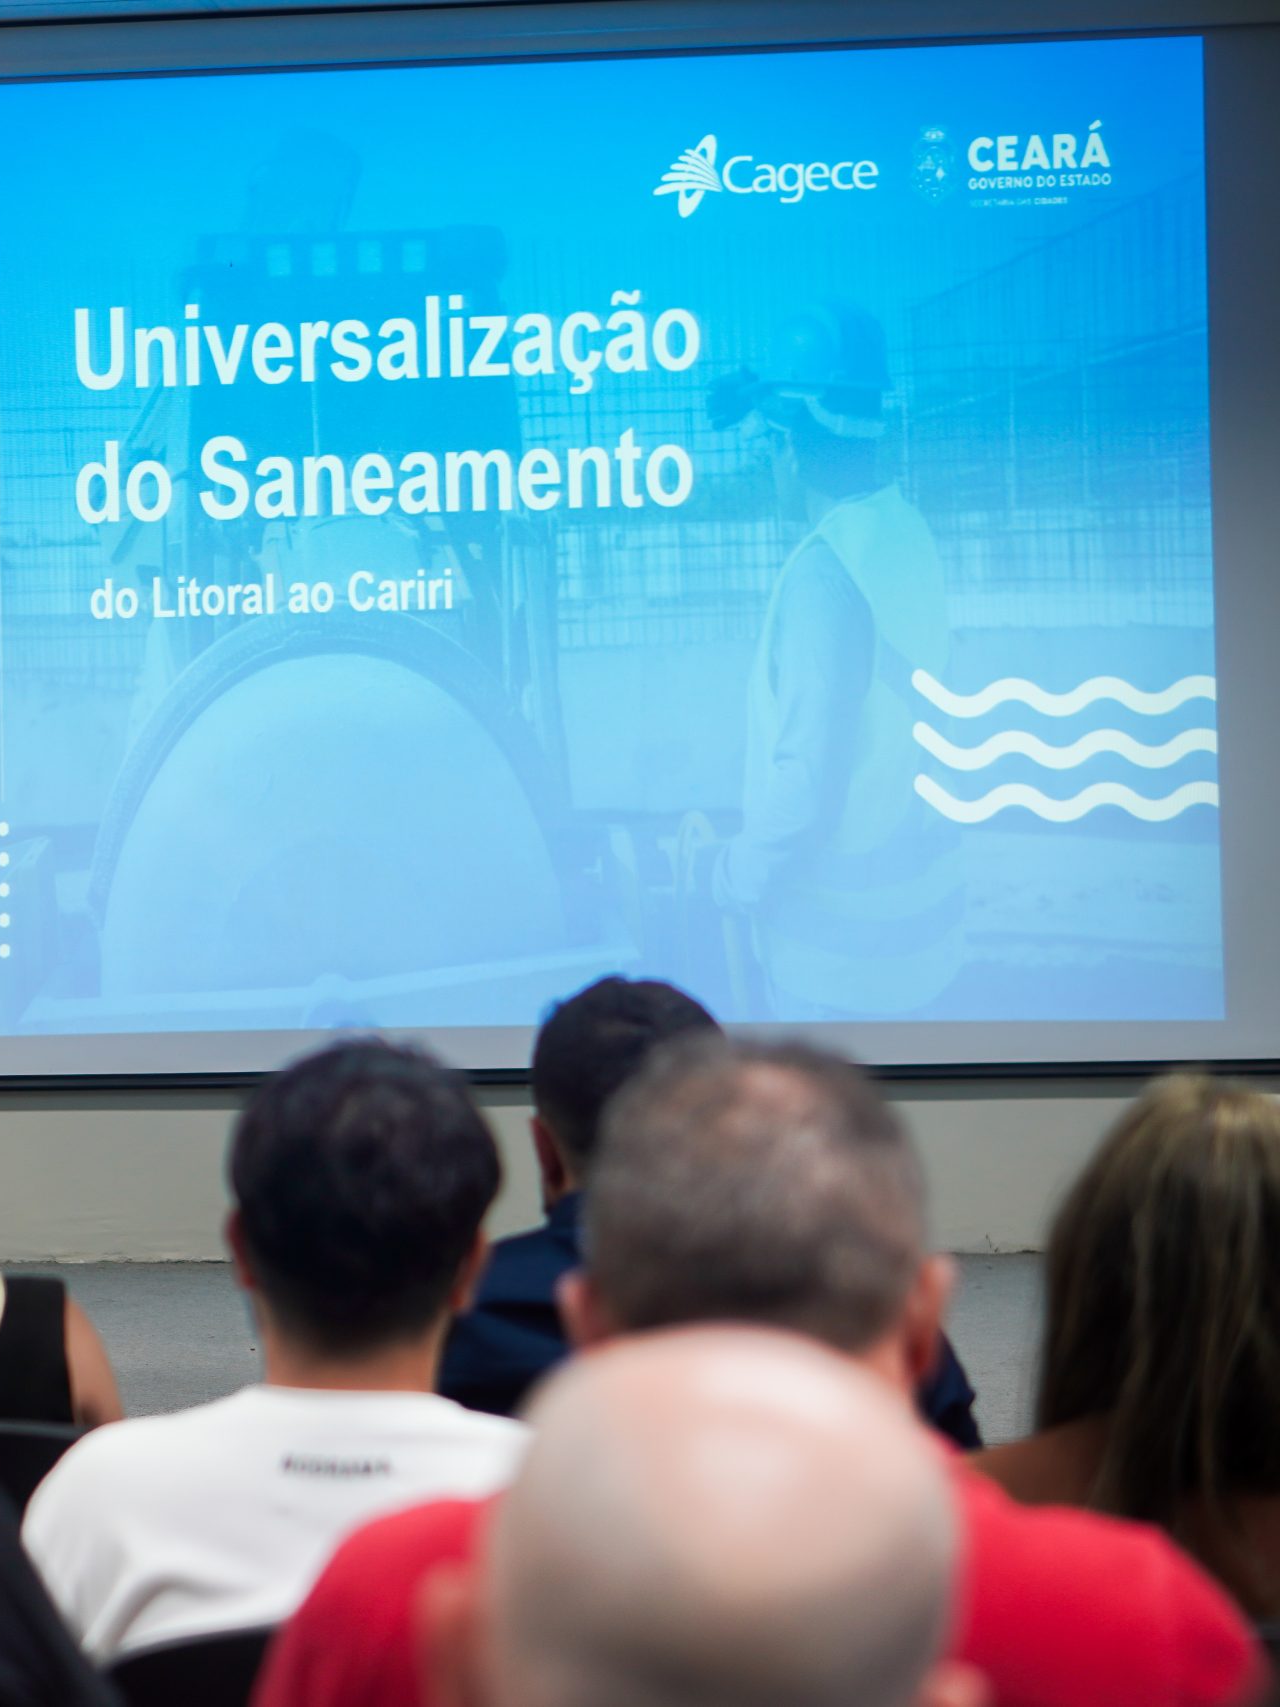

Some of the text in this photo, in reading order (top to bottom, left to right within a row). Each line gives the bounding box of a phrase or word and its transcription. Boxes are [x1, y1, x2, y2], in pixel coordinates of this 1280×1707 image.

[967, 119, 1111, 172] CEARÁ
[722, 155, 879, 203] Cagece
[967, 173, 1112, 190] GOVERNO DO ESTADO
[73, 289, 700, 395] Universalização
[75, 427, 695, 525] do Saneamento
[90, 568, 453, 620] do Litoral ao Cariri
